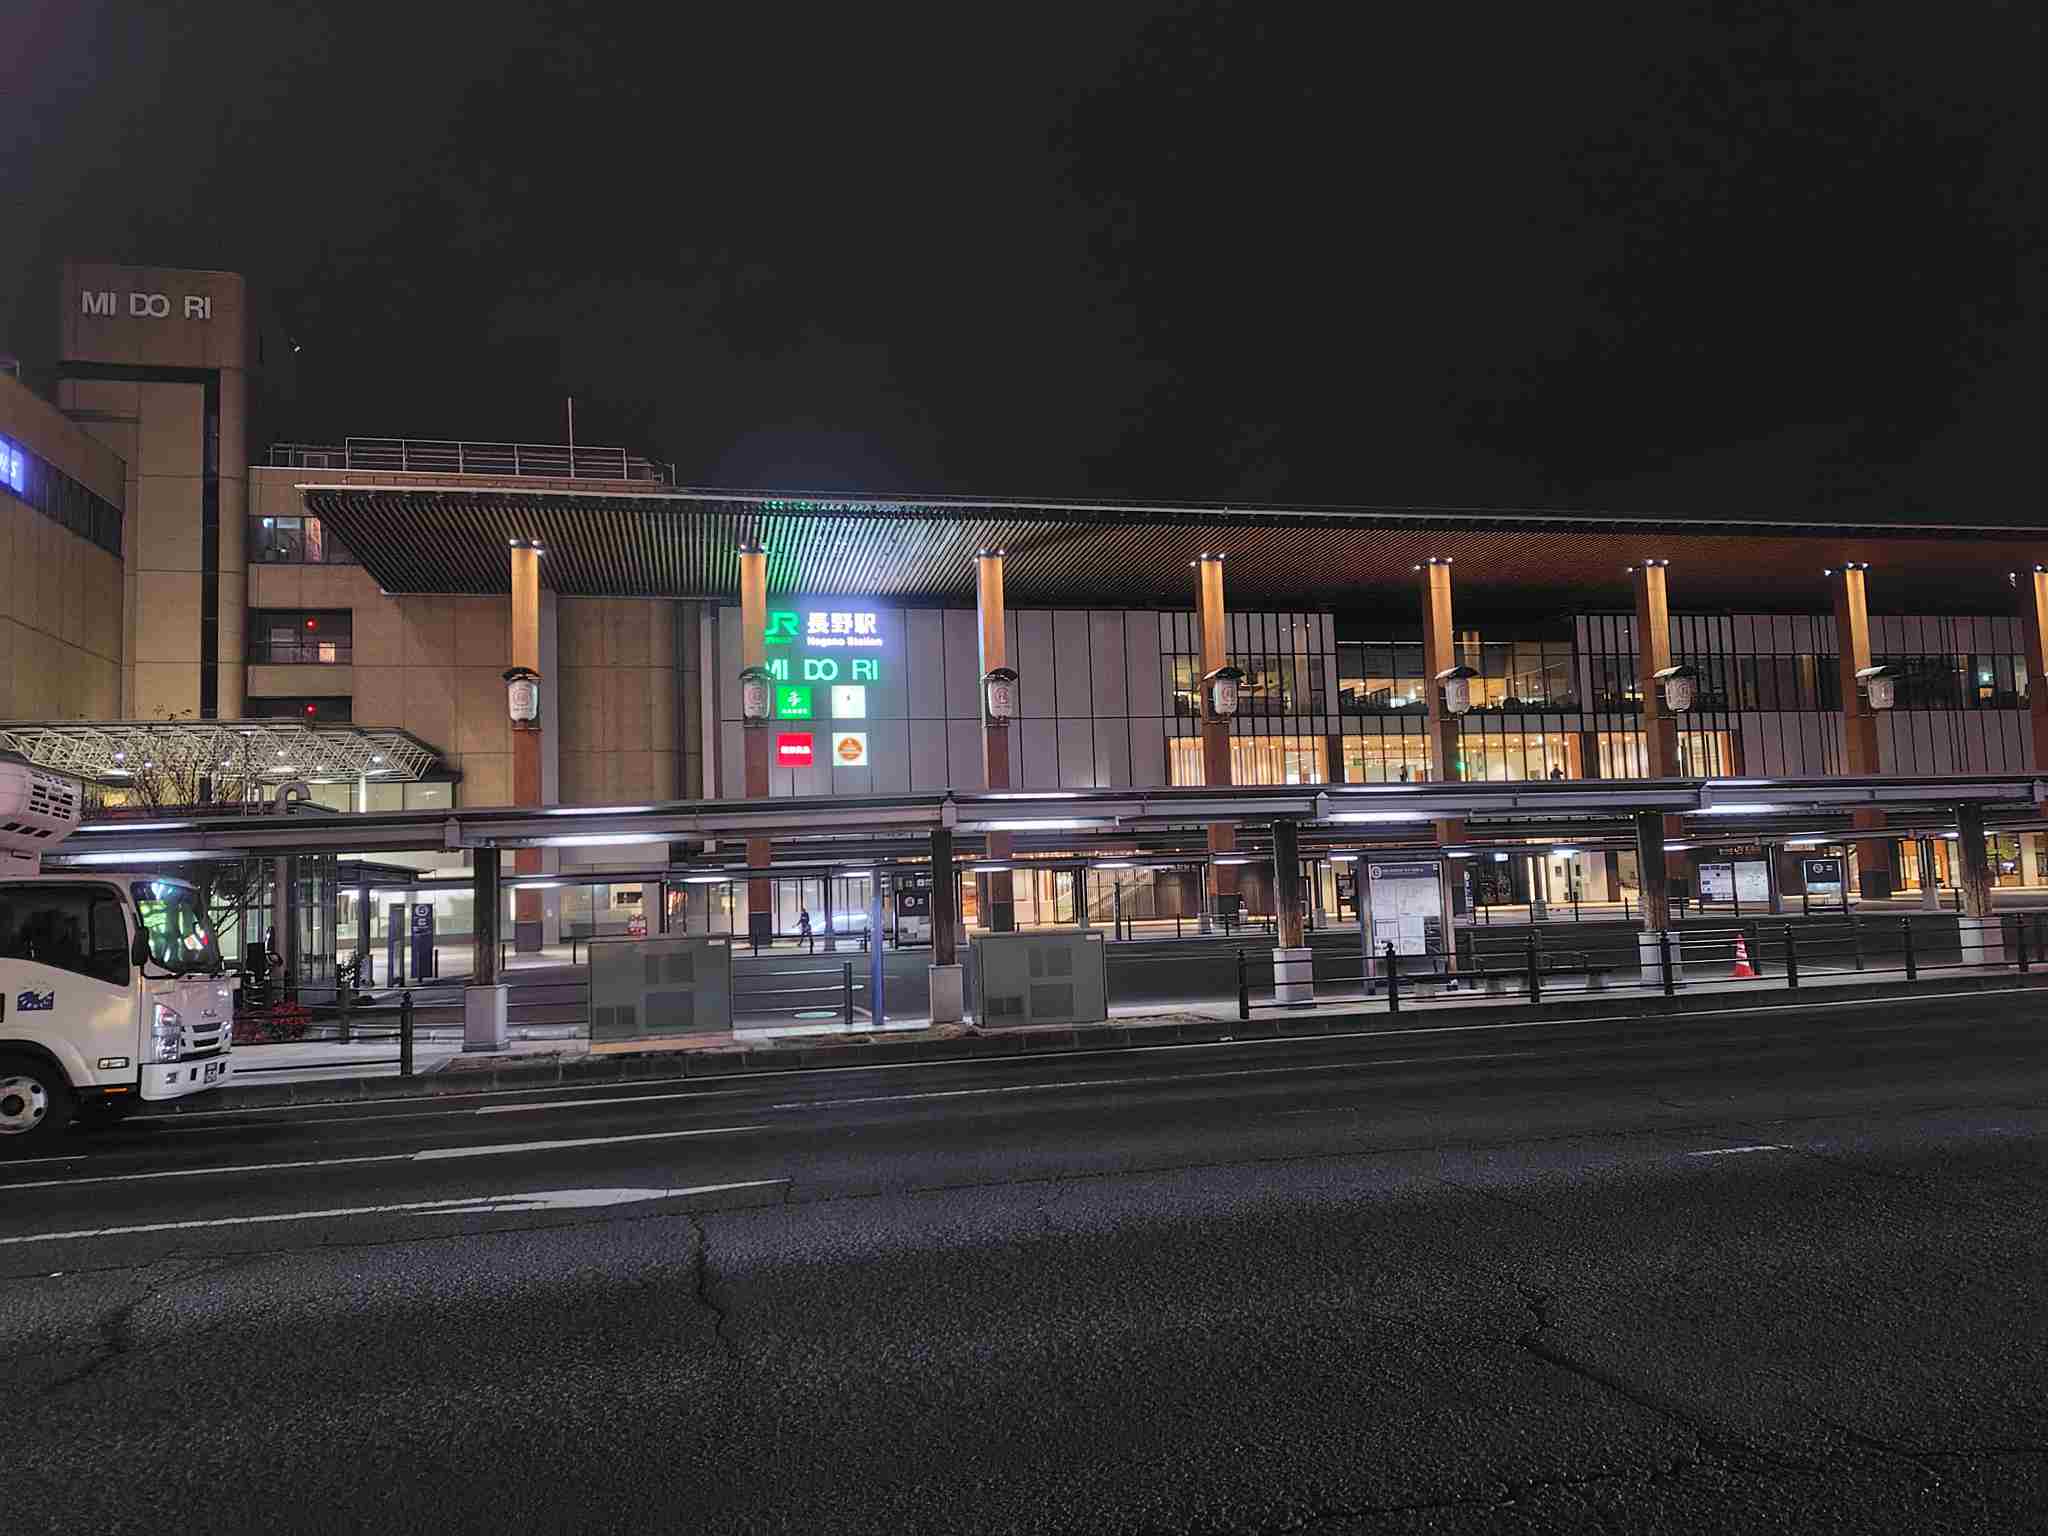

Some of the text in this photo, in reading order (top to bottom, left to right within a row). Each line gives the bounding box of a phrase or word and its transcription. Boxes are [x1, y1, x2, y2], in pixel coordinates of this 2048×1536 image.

[81, 291, 211, 319] MI DO RI
[765, 611, 800, 635] JR
[807, 612, 877, 634] 長野駅
[807, 636, 846, 647] Nagano
[847, 636, 883, 647] Station
[804, 658, 839, 680] DO
[852, 658, 879, 680] RI
